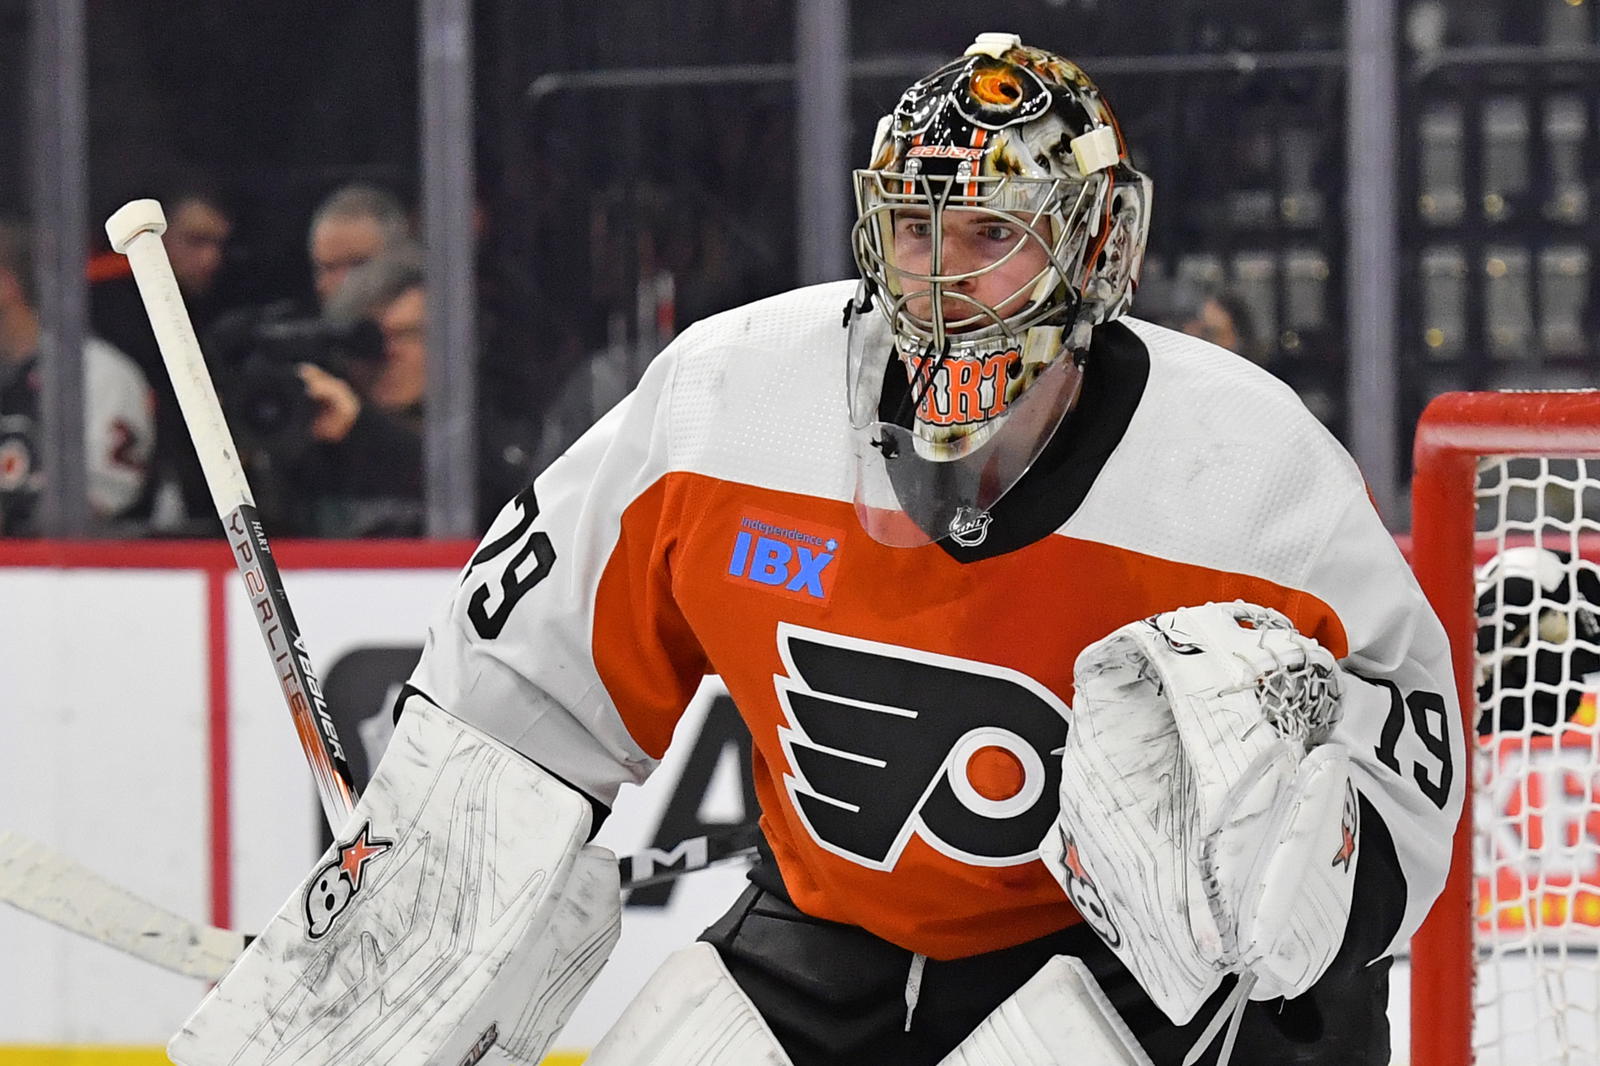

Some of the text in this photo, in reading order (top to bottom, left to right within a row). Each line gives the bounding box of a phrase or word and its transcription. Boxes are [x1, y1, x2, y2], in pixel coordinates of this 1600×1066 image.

[250, 519, 272, 555] HART
[727, 531, 835, 599] IBX
[298, 655, 348, 763] BAUER
[1345, 668, 1453, 811] 79
